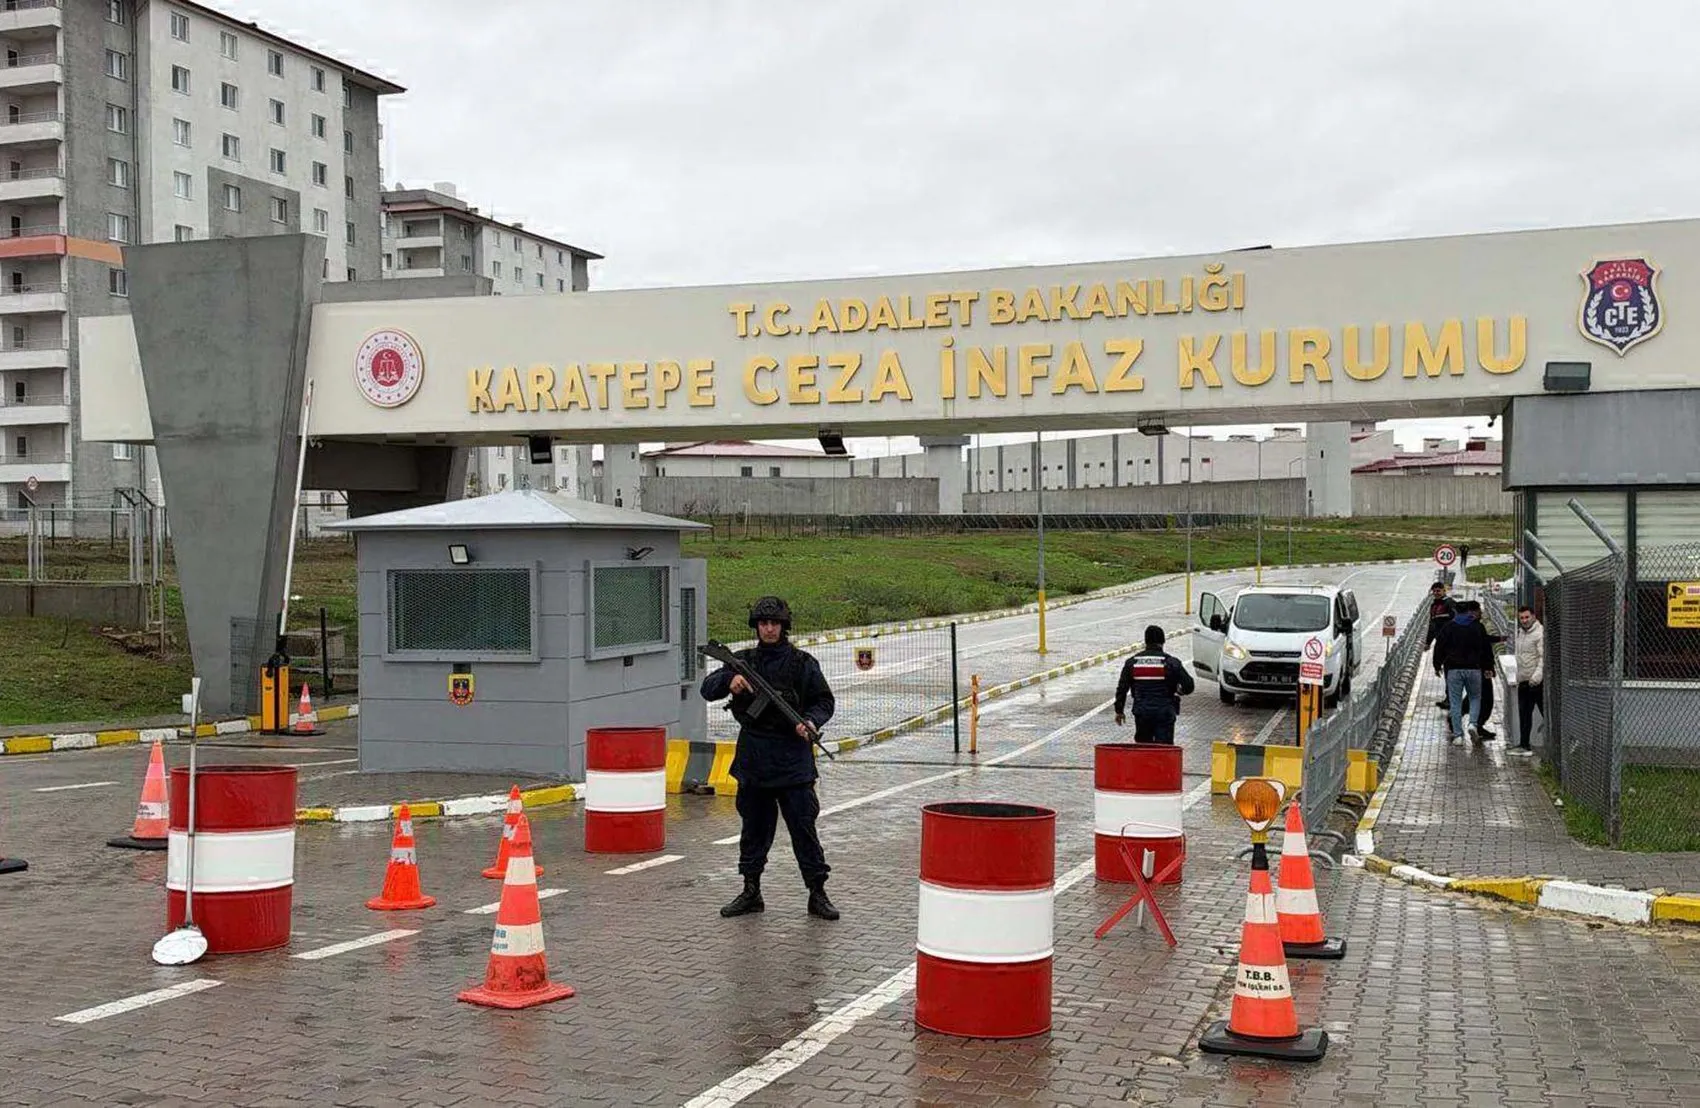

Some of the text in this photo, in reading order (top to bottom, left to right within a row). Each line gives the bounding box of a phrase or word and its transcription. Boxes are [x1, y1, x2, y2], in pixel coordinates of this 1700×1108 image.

[728, 262, 1246, 338] T.C. ADALET BAKANLIĞI
[467, 358, 716, 413] KARATEPE
[743, 347, 913, 406] CEZA
[941, 336, 1145, 400] İNFAZ
[1178, 315, 1528, 390] KURUMU
[1440, 551, 1453, 560] 20
[1245, 970, 1275, 981] T.B.B.
